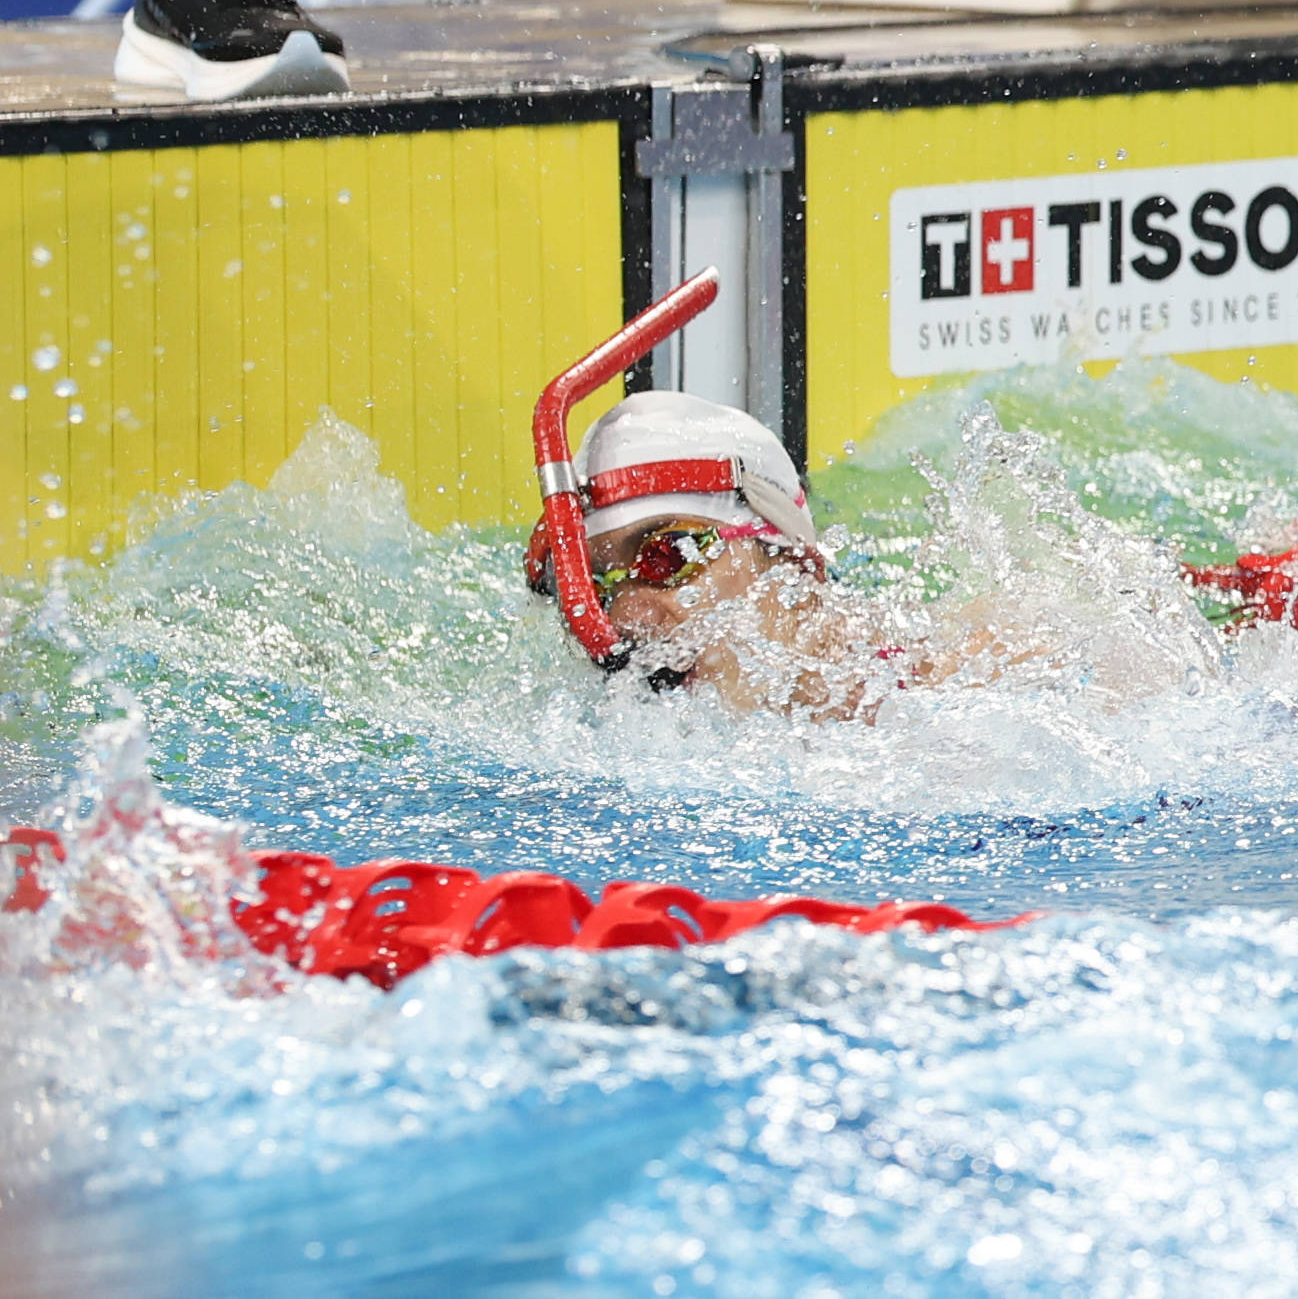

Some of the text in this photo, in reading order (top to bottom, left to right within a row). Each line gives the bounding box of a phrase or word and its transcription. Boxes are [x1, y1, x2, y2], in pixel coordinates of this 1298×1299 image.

[919, 316, 1011, 350] SWISS
[1031, 303, 1169, 339] WACHES
[1190, 293, 1279, 326] SINCE
